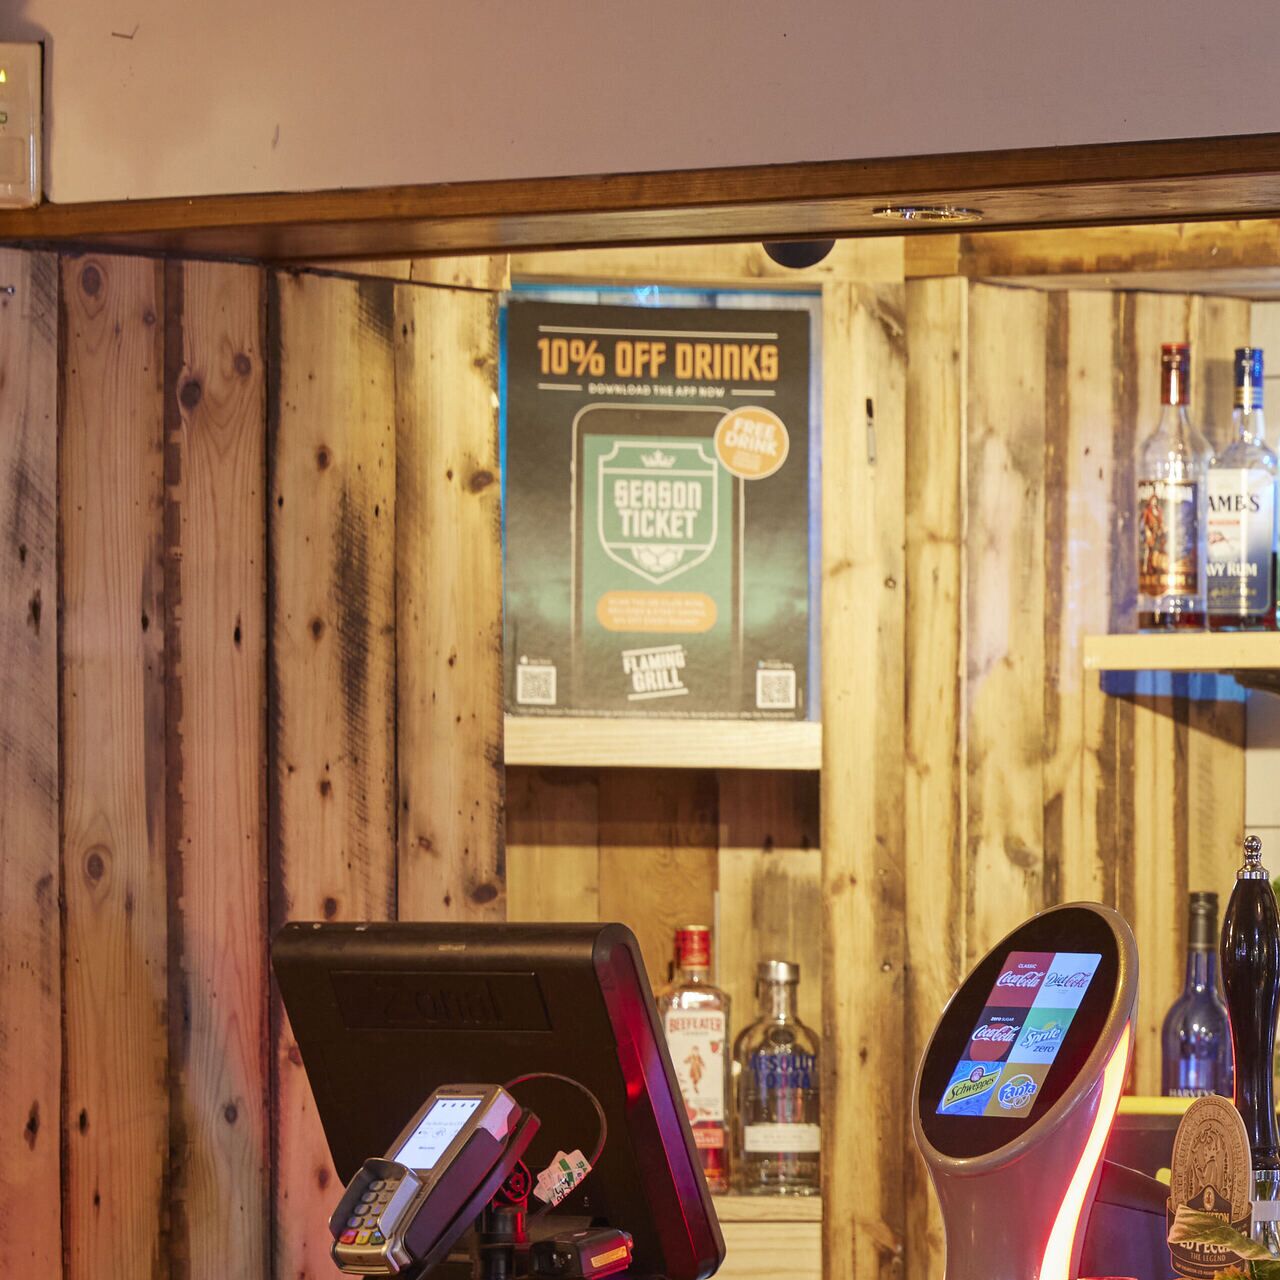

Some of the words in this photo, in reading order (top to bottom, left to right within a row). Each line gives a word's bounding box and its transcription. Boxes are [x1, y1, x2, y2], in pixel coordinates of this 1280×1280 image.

[538, 338, 605, 376] 10%
[615, 341, 666, 378] OFF
[675, 342, 779, 381] DRINKS
[588, 383, 650, 396] DOWNLOAD
[653, 384, 675, 396] THE
[676, 385, 697, 397] APP
[699, 386, 725, 398] NOW
[733, 417, 776, 435] FREE
[724, 431, 777, 456] DRINK
[614, 479, 702, 510] SEASON
[618, 509, 697, 539] TICKET
[623, 651, 686, 674] FLAMING
[632, 667, 684, 693] GRILL
[1045, 972, 1064, 987] Diet
[1063, 972, 1092, 988] Coke
[669, 1016, 722, 1033] BEEFEATER
[1021, 1027, 1061, 1048] Sprite
[947, 1074, 997, 1102] Schweppes
[999, 1080, 1037, 1102] Fanta
[1190, 1252, 1200, 1261] THE
[1202, 1253, 1226, 1262] LEGEND
